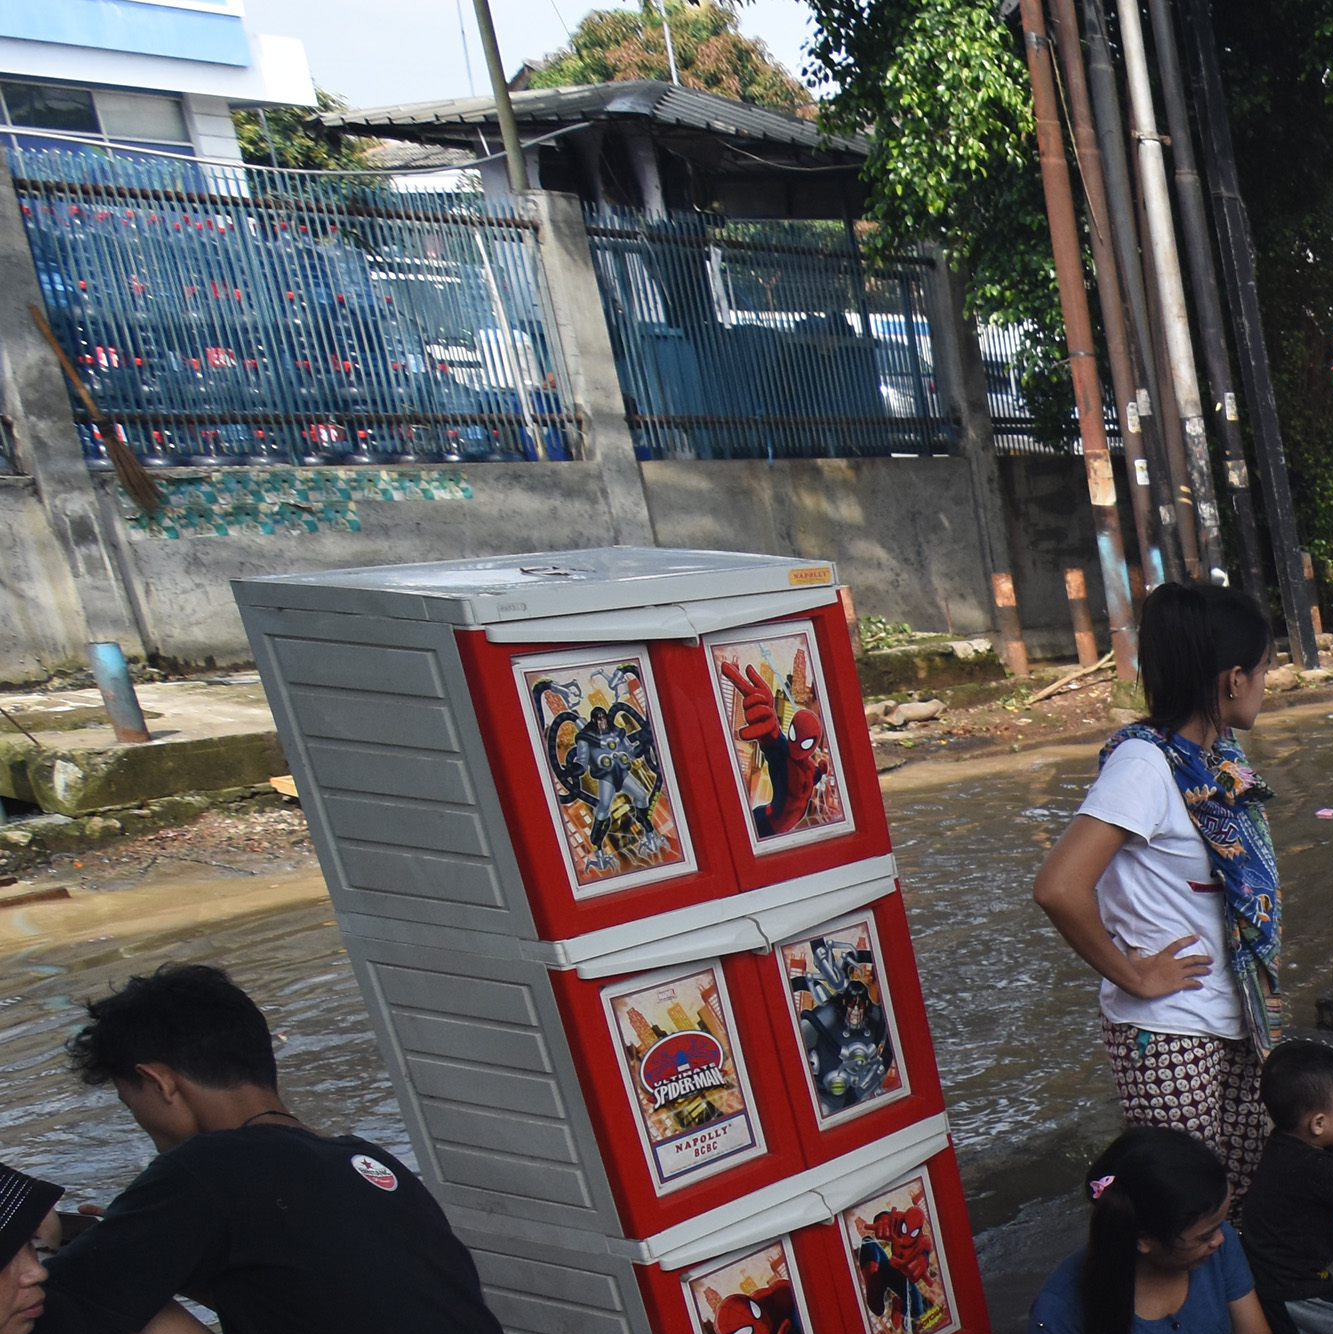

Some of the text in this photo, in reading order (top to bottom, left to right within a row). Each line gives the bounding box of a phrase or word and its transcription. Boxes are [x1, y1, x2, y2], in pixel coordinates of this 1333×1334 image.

[653, 1067, 726, 1110] SPIDER-MAN
[674, 1126, 729, 1154] NAPOLLY
[693, 1141, 719, 1158] BCBC
